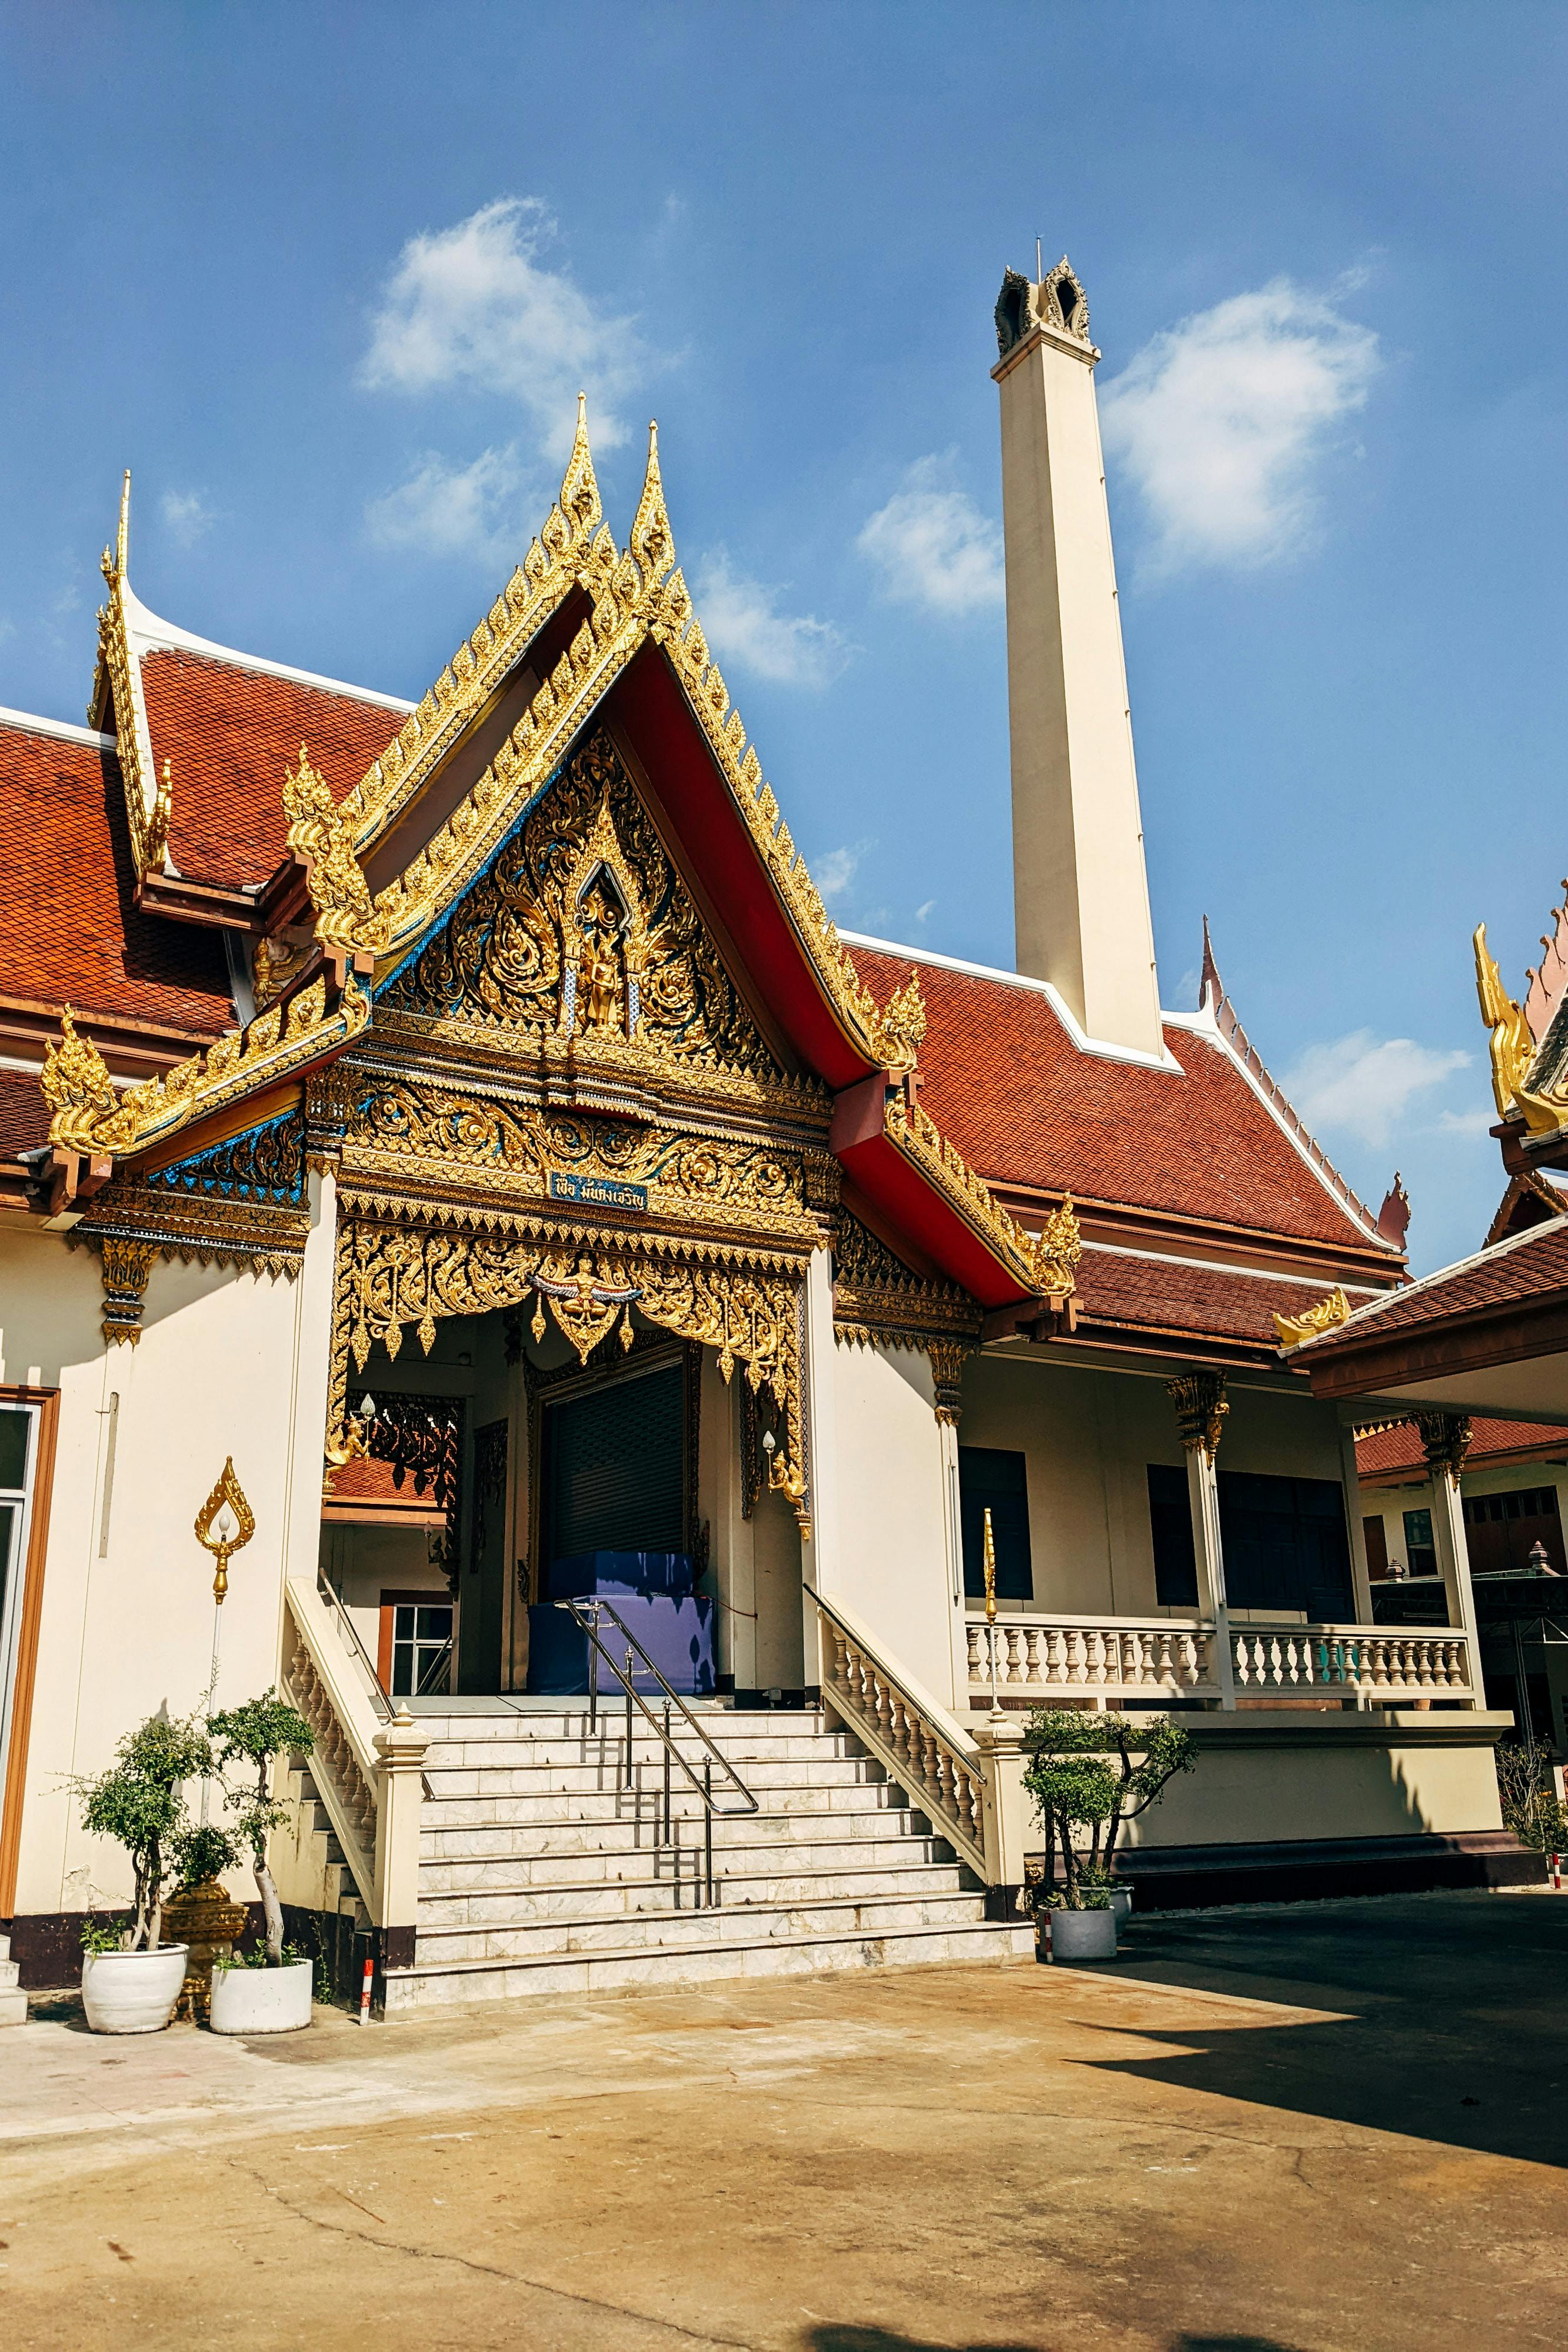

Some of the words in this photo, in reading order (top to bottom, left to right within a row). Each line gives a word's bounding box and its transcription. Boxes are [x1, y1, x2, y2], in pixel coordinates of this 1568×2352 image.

[581, 1179, 643, 1210] มั่นคงเจริญ
